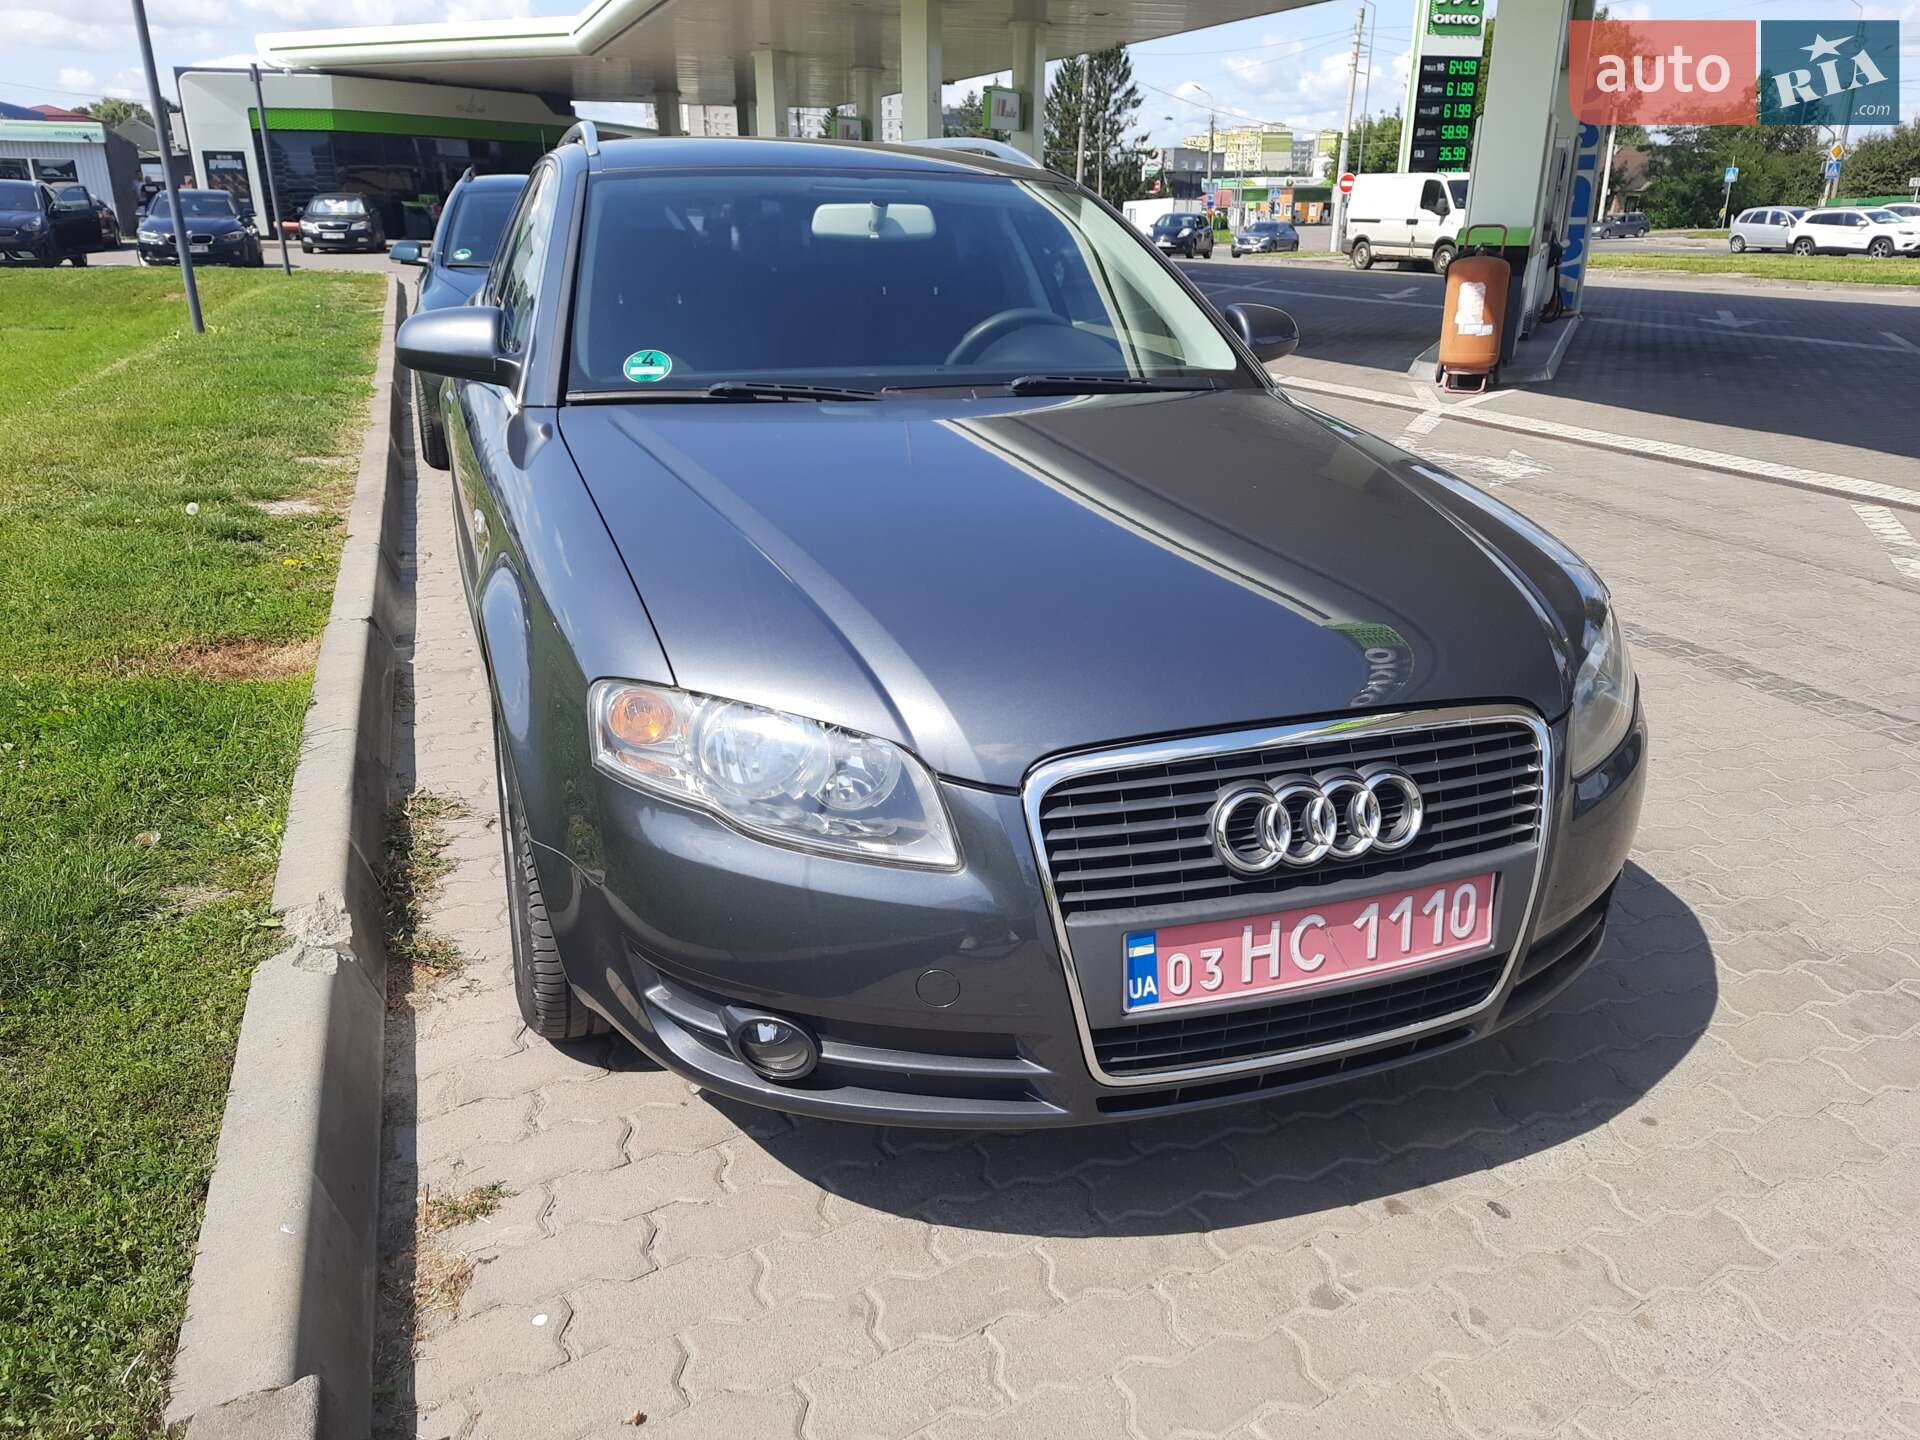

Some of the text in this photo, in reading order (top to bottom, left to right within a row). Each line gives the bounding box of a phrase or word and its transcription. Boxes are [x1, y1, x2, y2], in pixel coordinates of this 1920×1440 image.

[1433, 14, 1480, 25] OKKO
[1448, 60, 1477, 75] 64.99
[1441, 125, 1469, 140] 58.99
[1438, 146, 1466, 161] 35.99
[641, 352, 656, 366] 4
[1166, 883, 1477, 996] 03 HC 1110
[1129, 979, 1158, 999] UA
